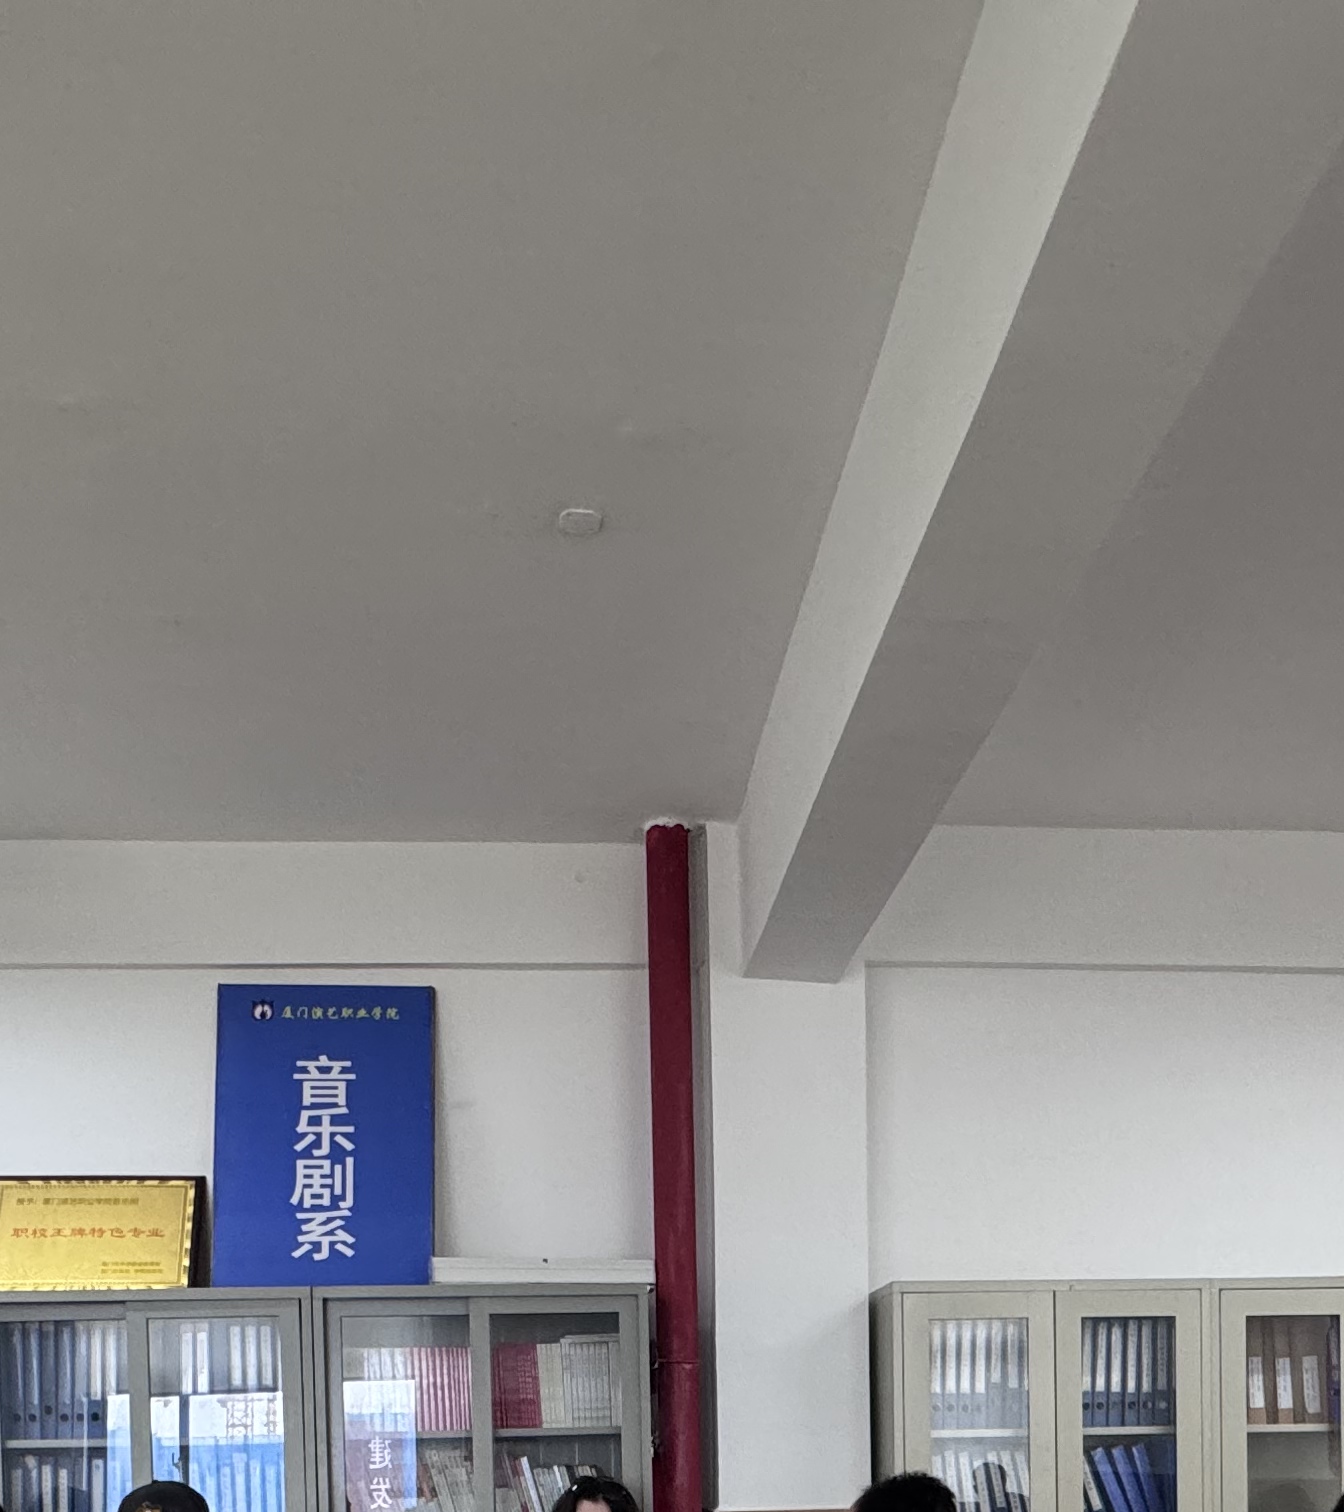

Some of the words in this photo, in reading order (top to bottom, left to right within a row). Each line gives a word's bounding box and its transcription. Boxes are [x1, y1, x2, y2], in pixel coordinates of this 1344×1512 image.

[290, 1054, 356, 1261] 音乐剧系
[11, 1227, 165, 1239] 职校王牌特色专业
